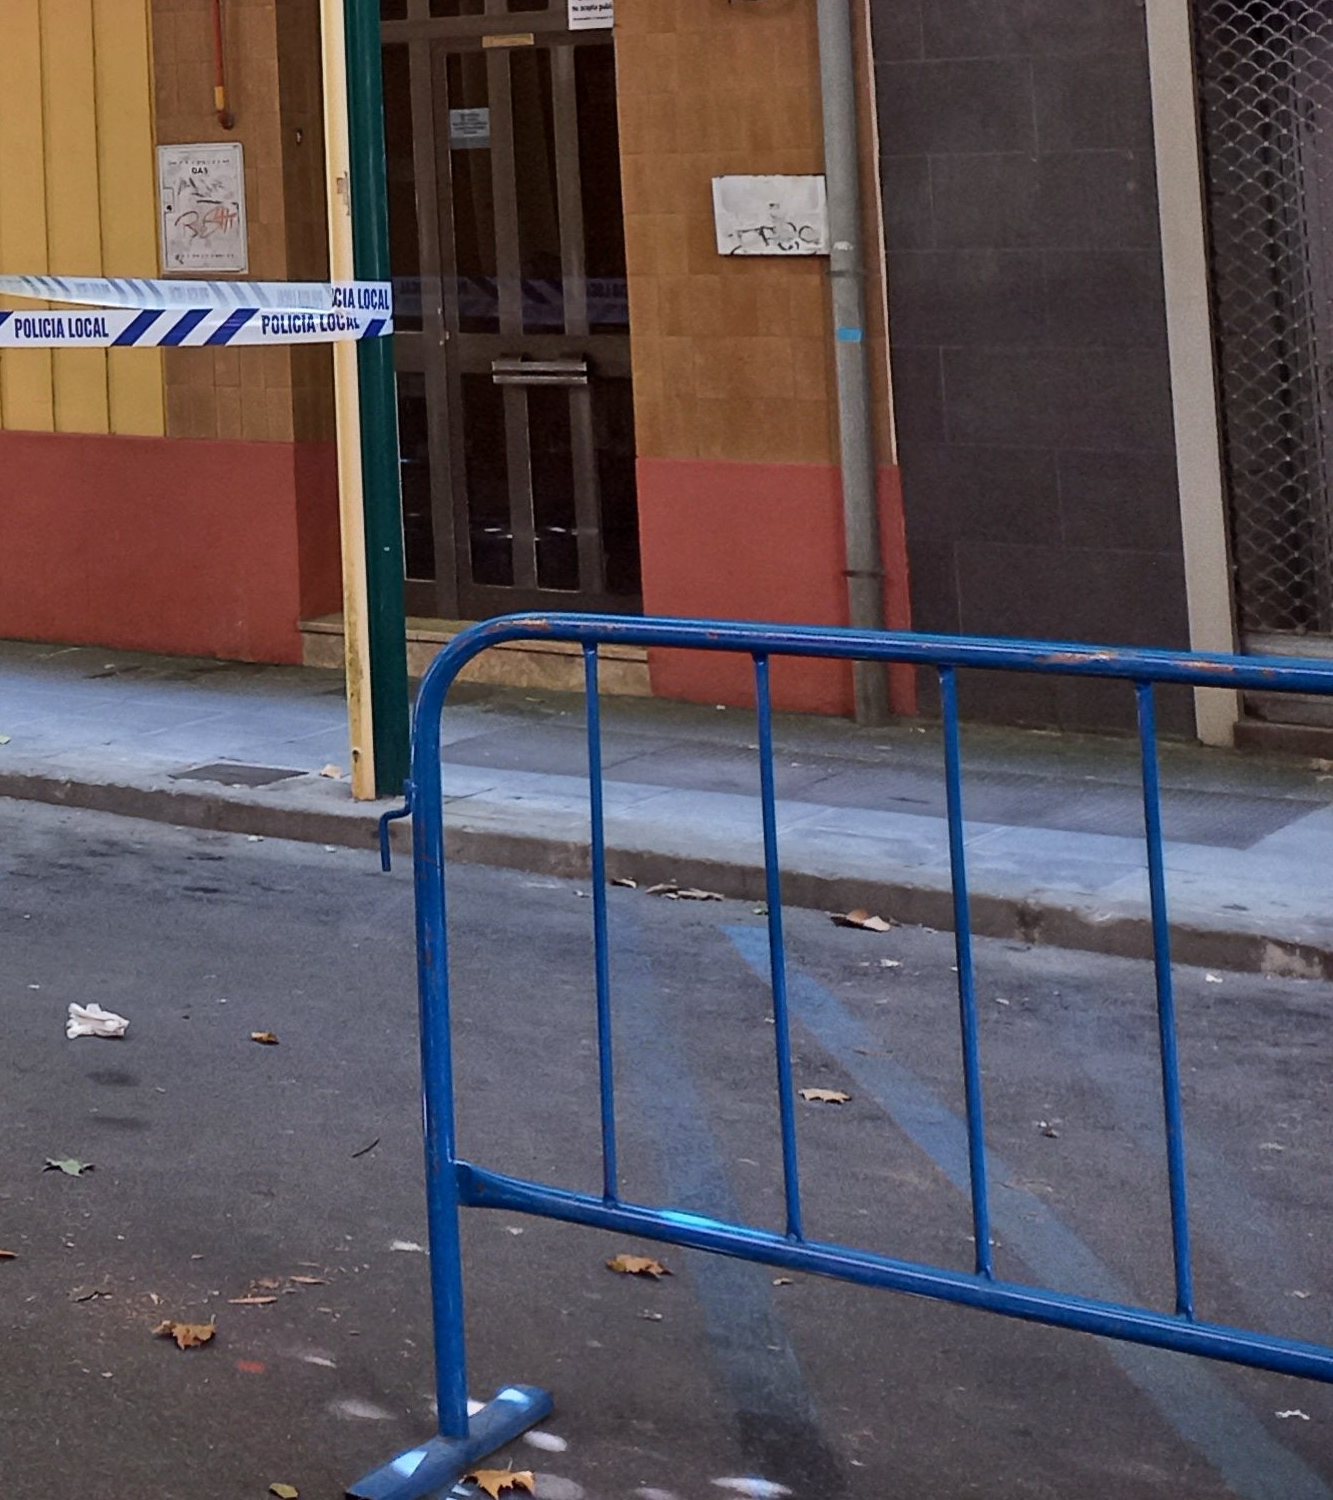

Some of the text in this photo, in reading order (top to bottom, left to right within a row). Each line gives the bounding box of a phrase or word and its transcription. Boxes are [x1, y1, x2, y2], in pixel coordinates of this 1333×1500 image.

[357, 288, 390, 311] LOCAL
[14, 316, 109, 339] POLICIA LOCAL
[261, 312, 361, 336] POLICIA LOCAL
